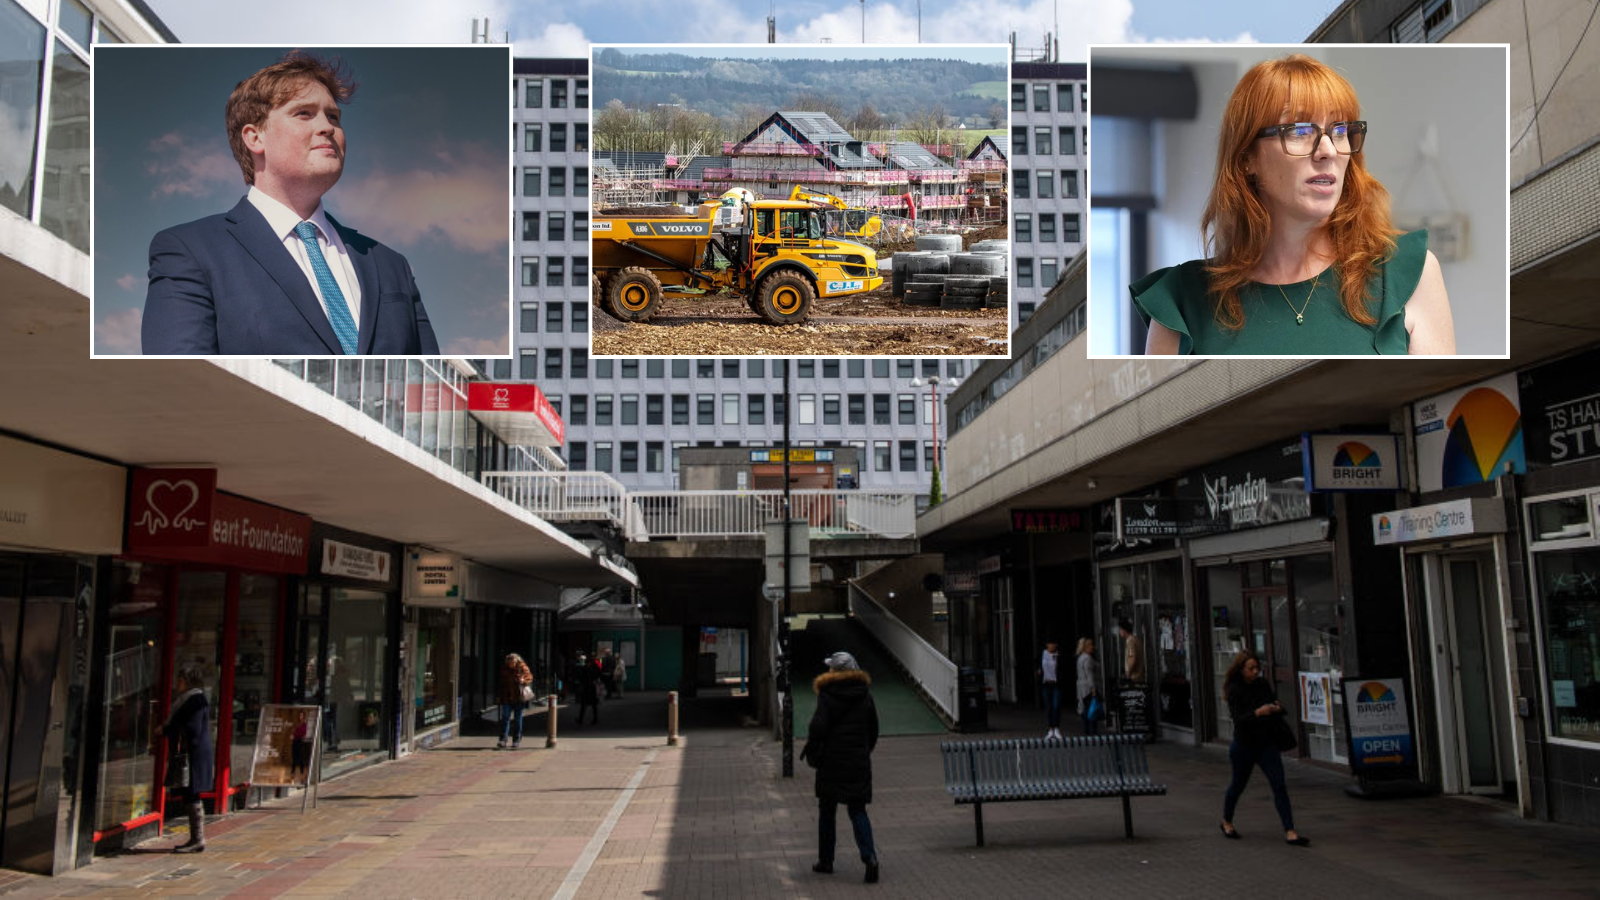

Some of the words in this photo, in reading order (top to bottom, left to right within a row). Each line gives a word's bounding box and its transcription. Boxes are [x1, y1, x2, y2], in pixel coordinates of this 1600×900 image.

[1333, 468, 1381, 479] BRIGHT
[1220, 471, 1268, 512] London
[1013, 510, 1082, 531] TATTOO
[1125, 516, 1159, 527] London
[1400, 512, 1433, 534] Training
[1433, 509, 1465, 529] Centre
[212, 518, 239, 546] eart
[241, 520, 304, 557] Foundation
[1357, 703, 1396, 713] BRIGHT
[1362, 738, 1401, 753] OPEN
